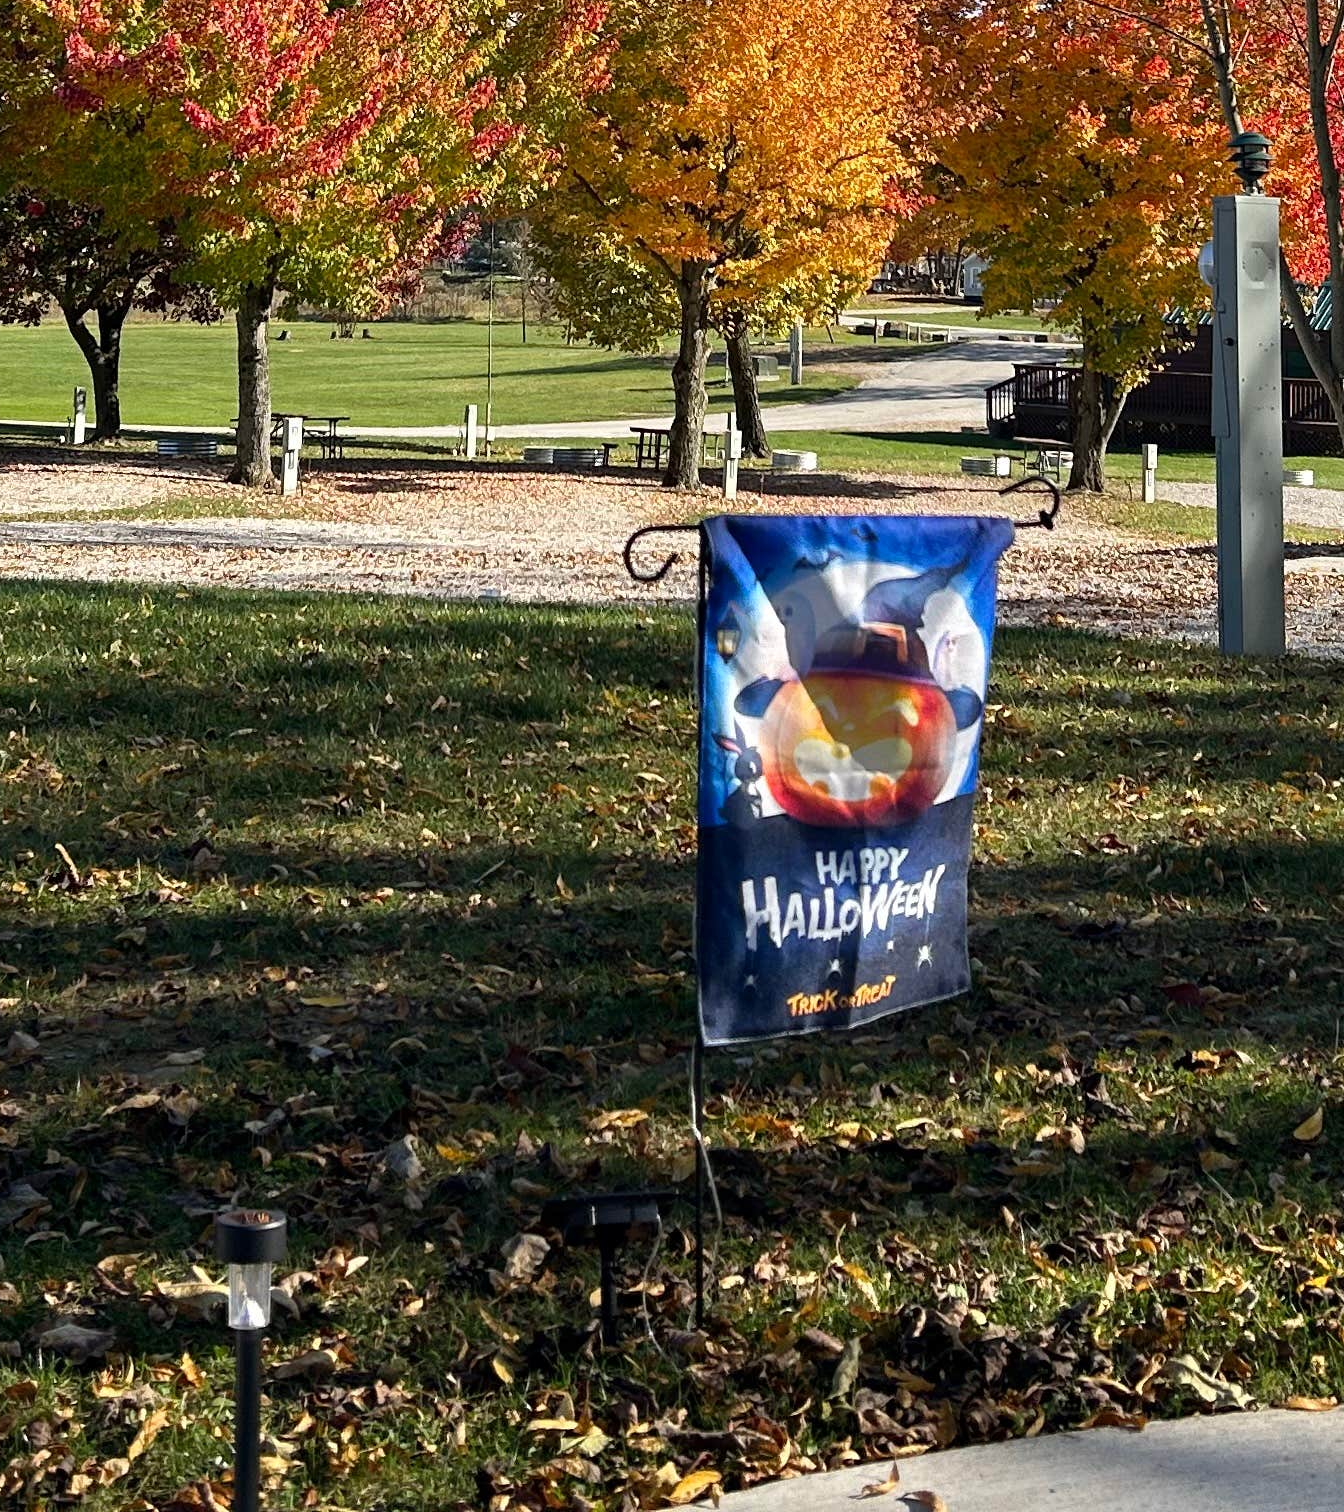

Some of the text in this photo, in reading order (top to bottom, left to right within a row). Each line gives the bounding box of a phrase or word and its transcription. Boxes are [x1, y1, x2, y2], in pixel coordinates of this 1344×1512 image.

[815, 847, 909, 886] HAPPY
[741, 863, 946, 951] HALLOWEEN
[787, 989, 838, 1016] TRICK
[855, 975, 896, 1008] TREAT
